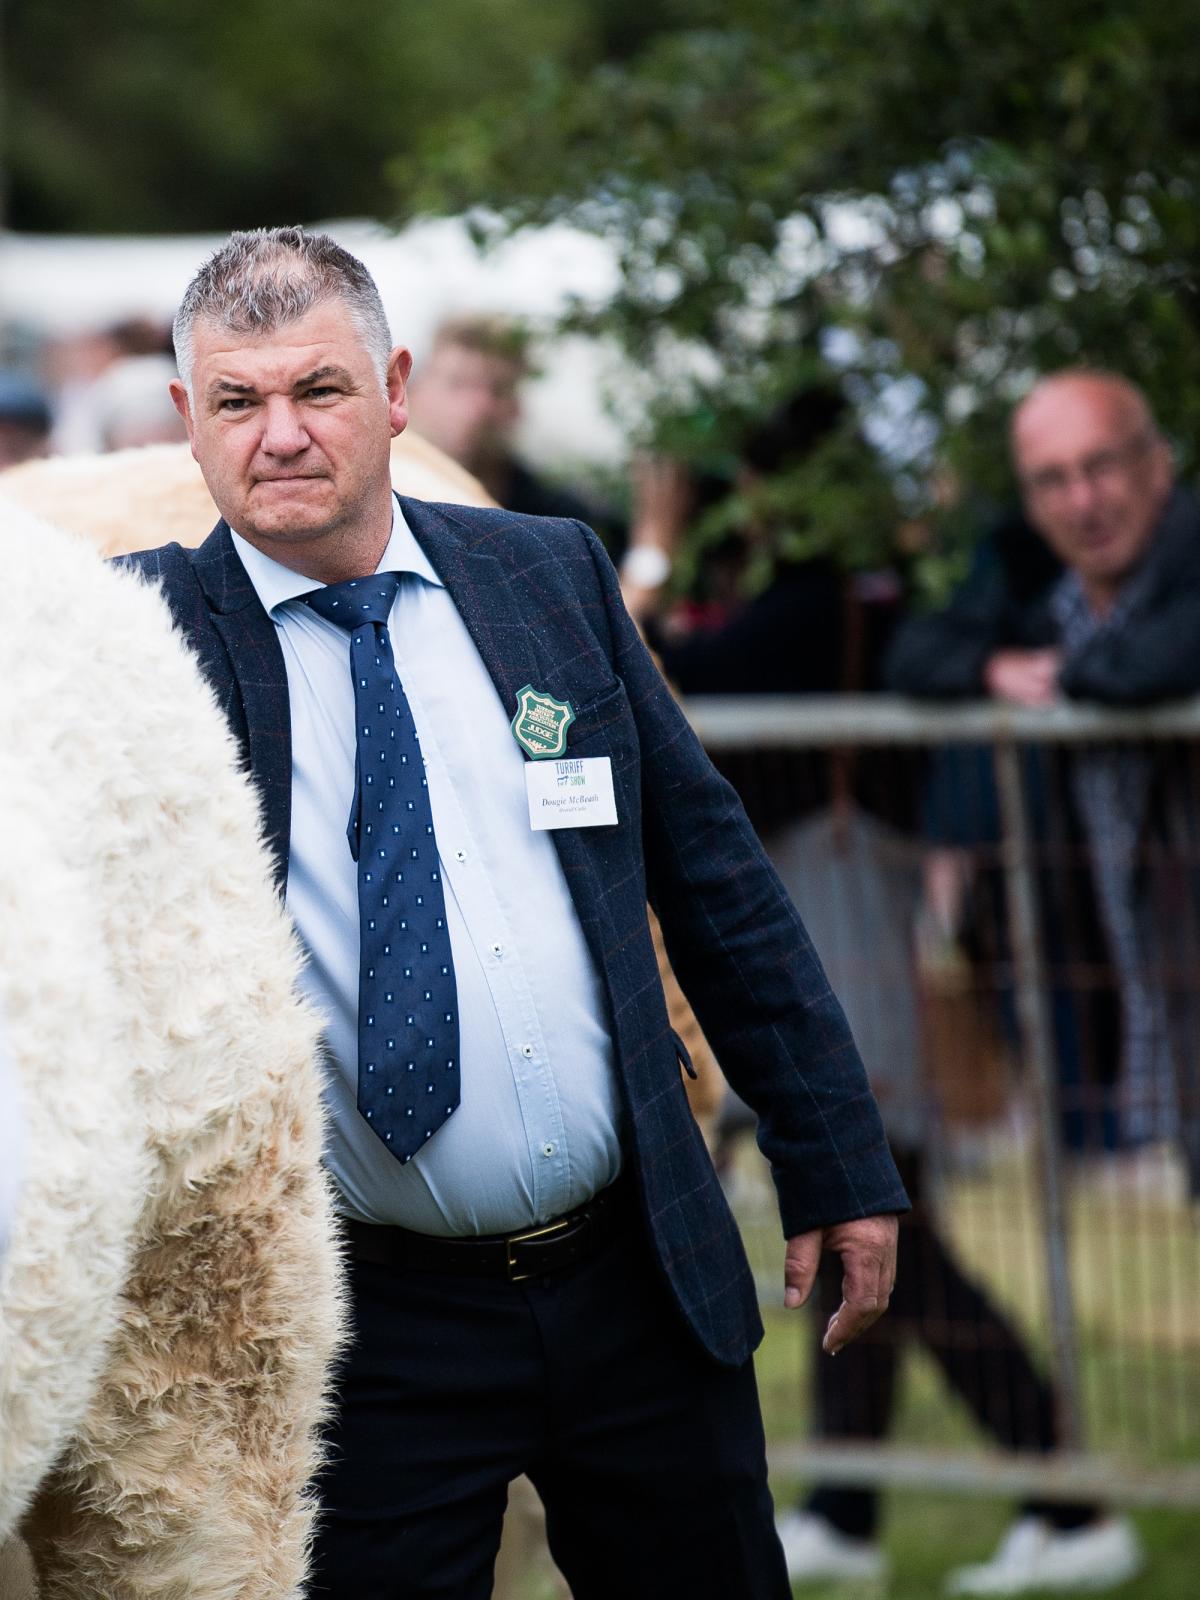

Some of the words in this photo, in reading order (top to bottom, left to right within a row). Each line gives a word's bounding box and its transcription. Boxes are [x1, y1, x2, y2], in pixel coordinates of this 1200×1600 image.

[527, 724, 554, 740] JUDGE
[555, 760, 584, 775] TURRIFF
[570, 775, 586, 786] SHOW
[542, 797, 567, 807] Dougie
